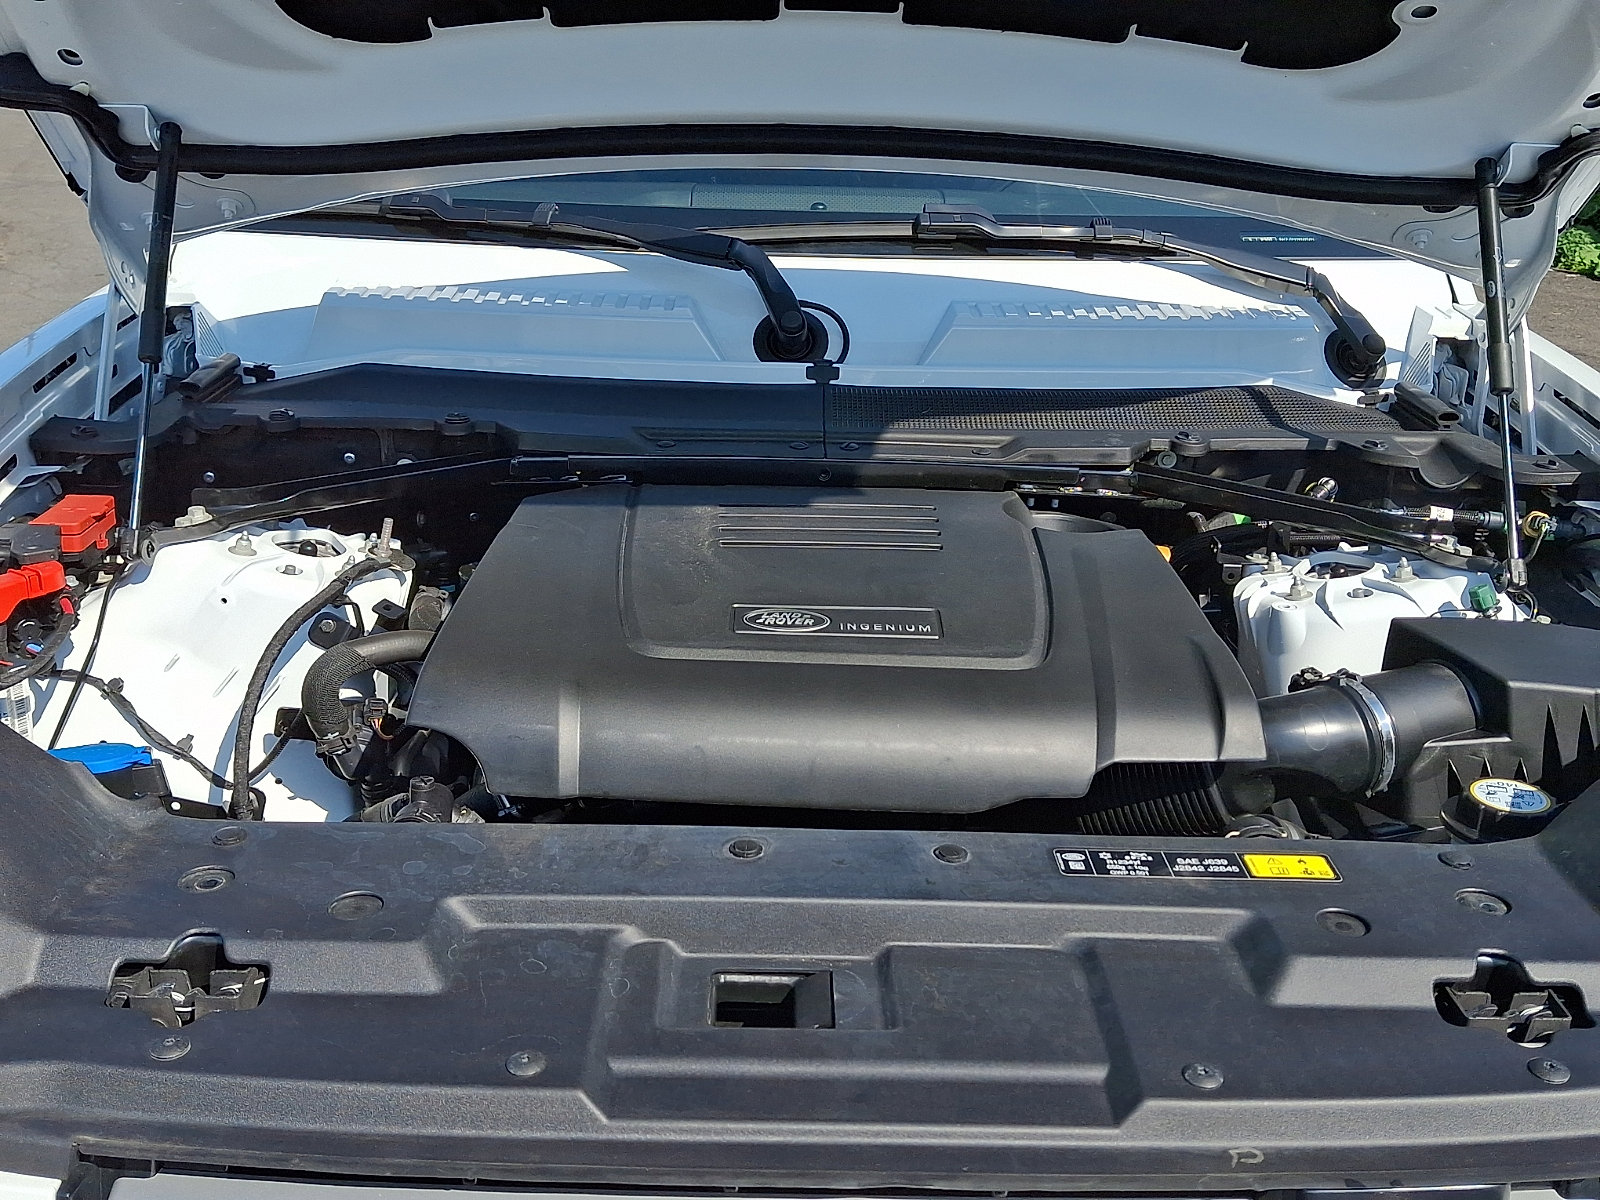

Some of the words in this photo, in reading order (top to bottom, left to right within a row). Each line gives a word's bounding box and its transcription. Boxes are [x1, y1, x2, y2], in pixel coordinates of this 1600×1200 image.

[765, 618, 815, 626] ROVER
[839, 622, 932, 633] INGENIUM
[1176, 857, 1200, 865] SAE
